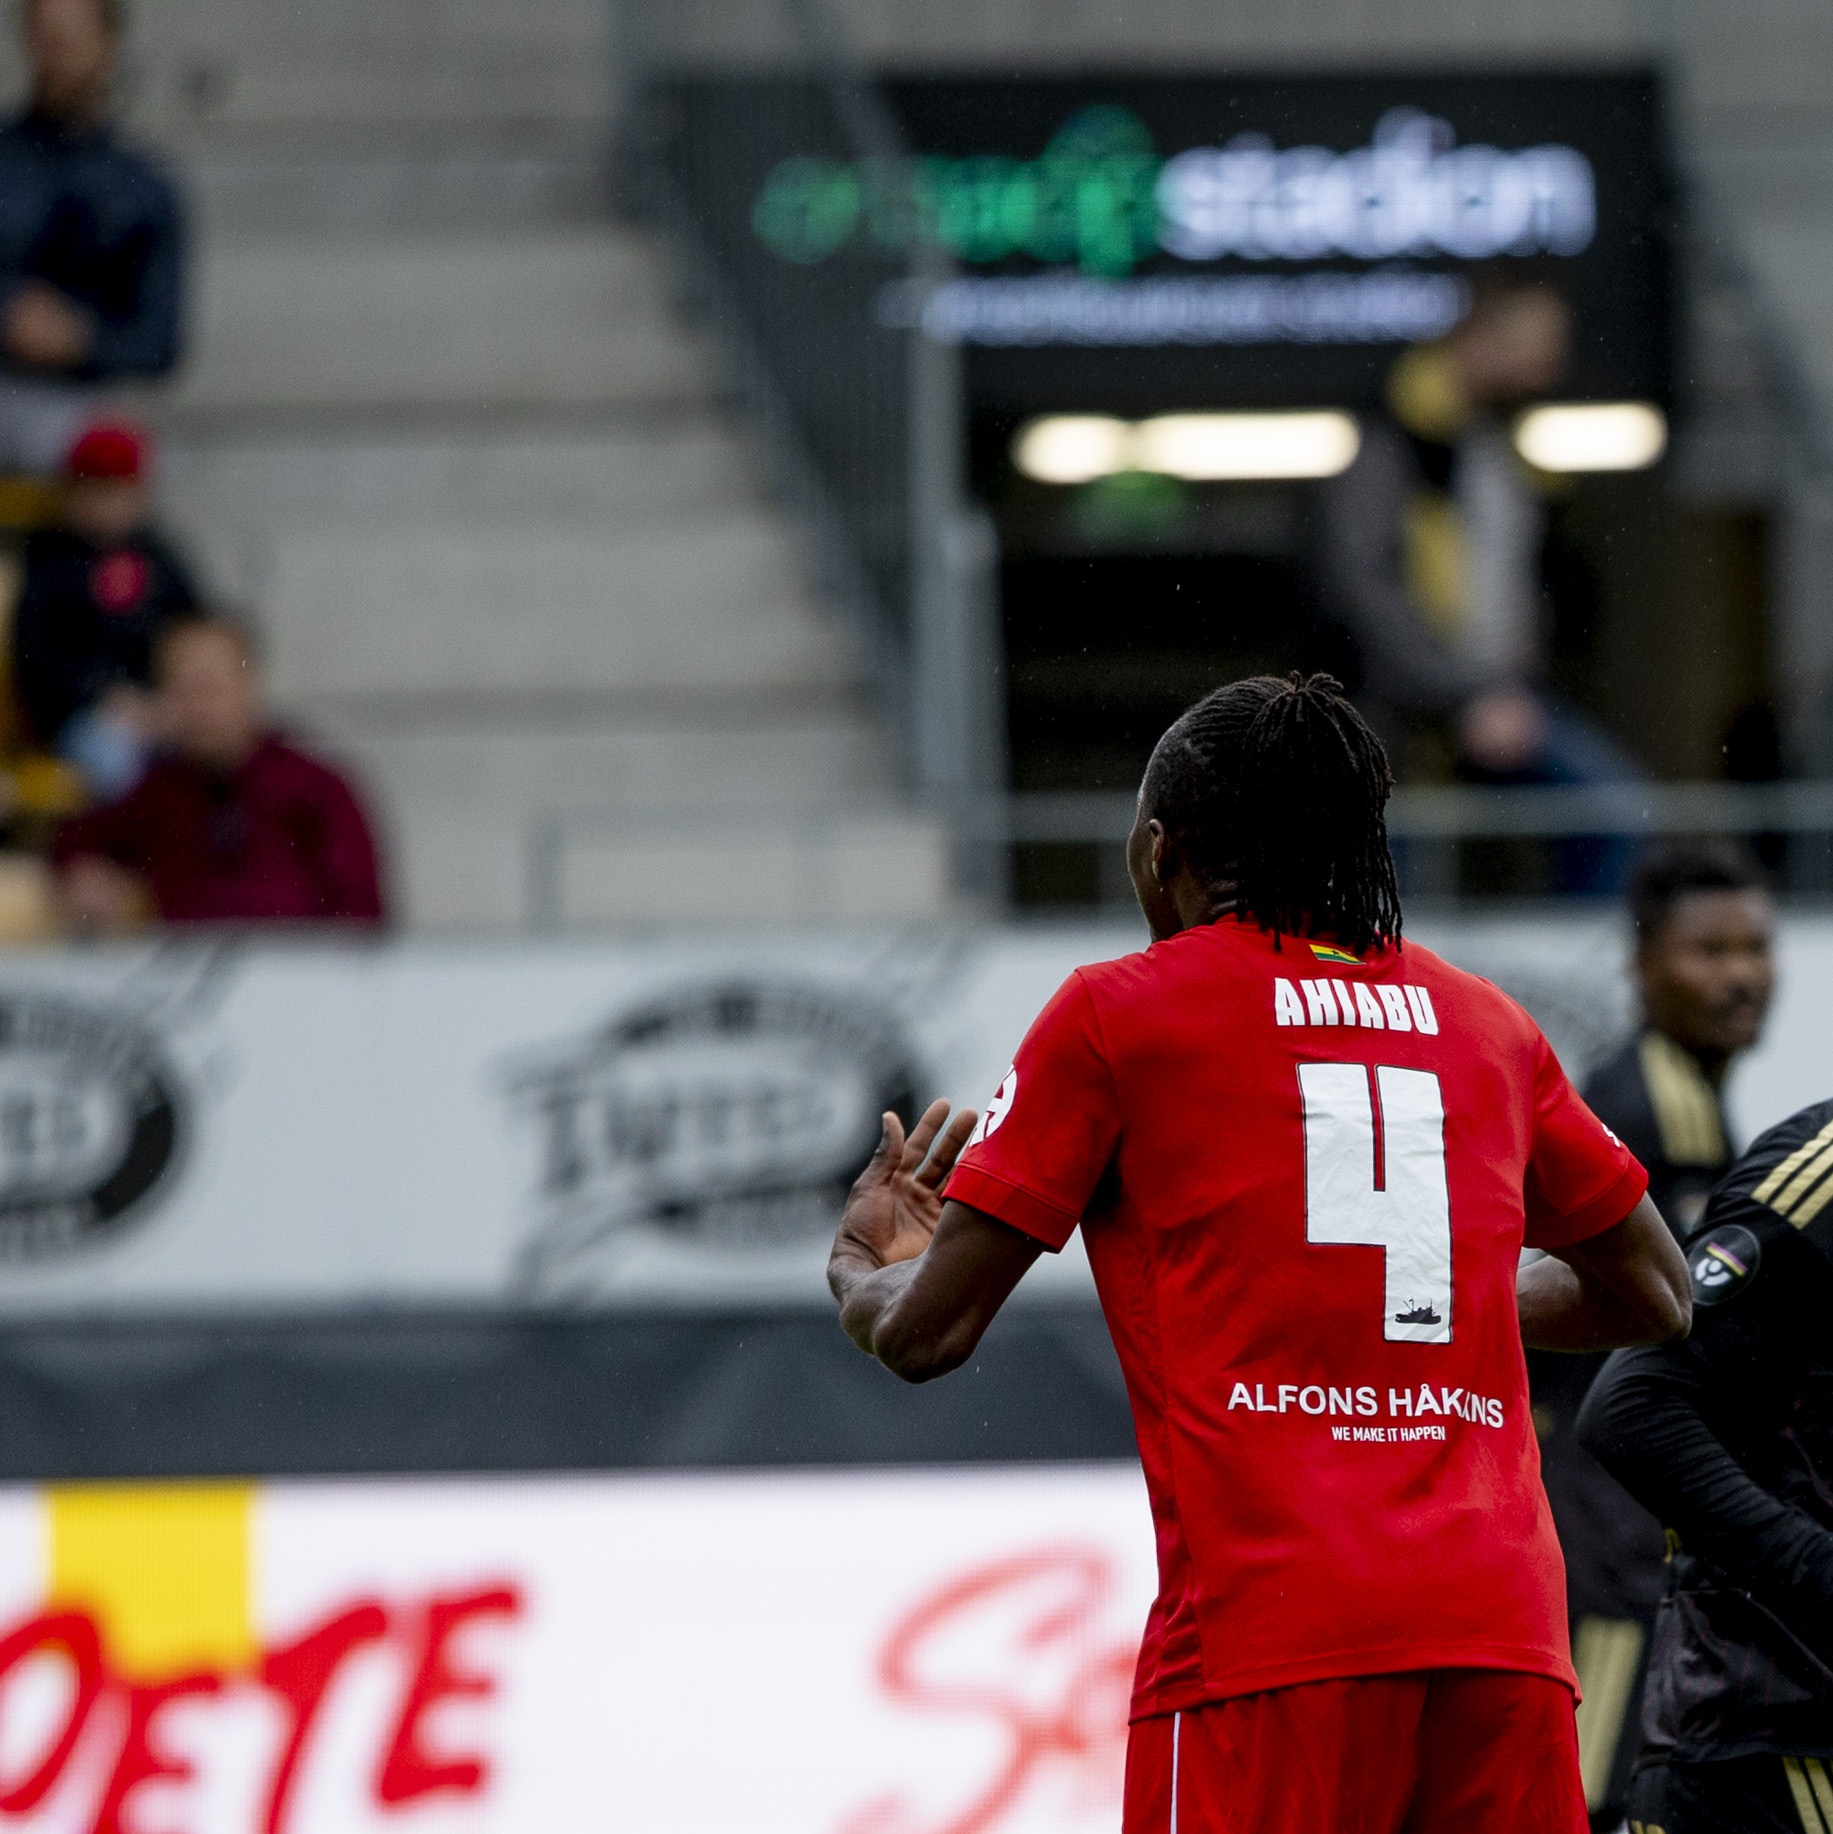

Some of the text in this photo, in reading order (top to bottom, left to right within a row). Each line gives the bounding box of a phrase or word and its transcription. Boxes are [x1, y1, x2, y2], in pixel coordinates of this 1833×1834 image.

[1274, 977, 1439, 1036] AHIABU
[1296, 1062, 1453, 1344] 4
[1227, 1383, 1378, 1417] ALFONS
[1331, 1426, 1446, 1442] WE MAKE IT HAPPEN
